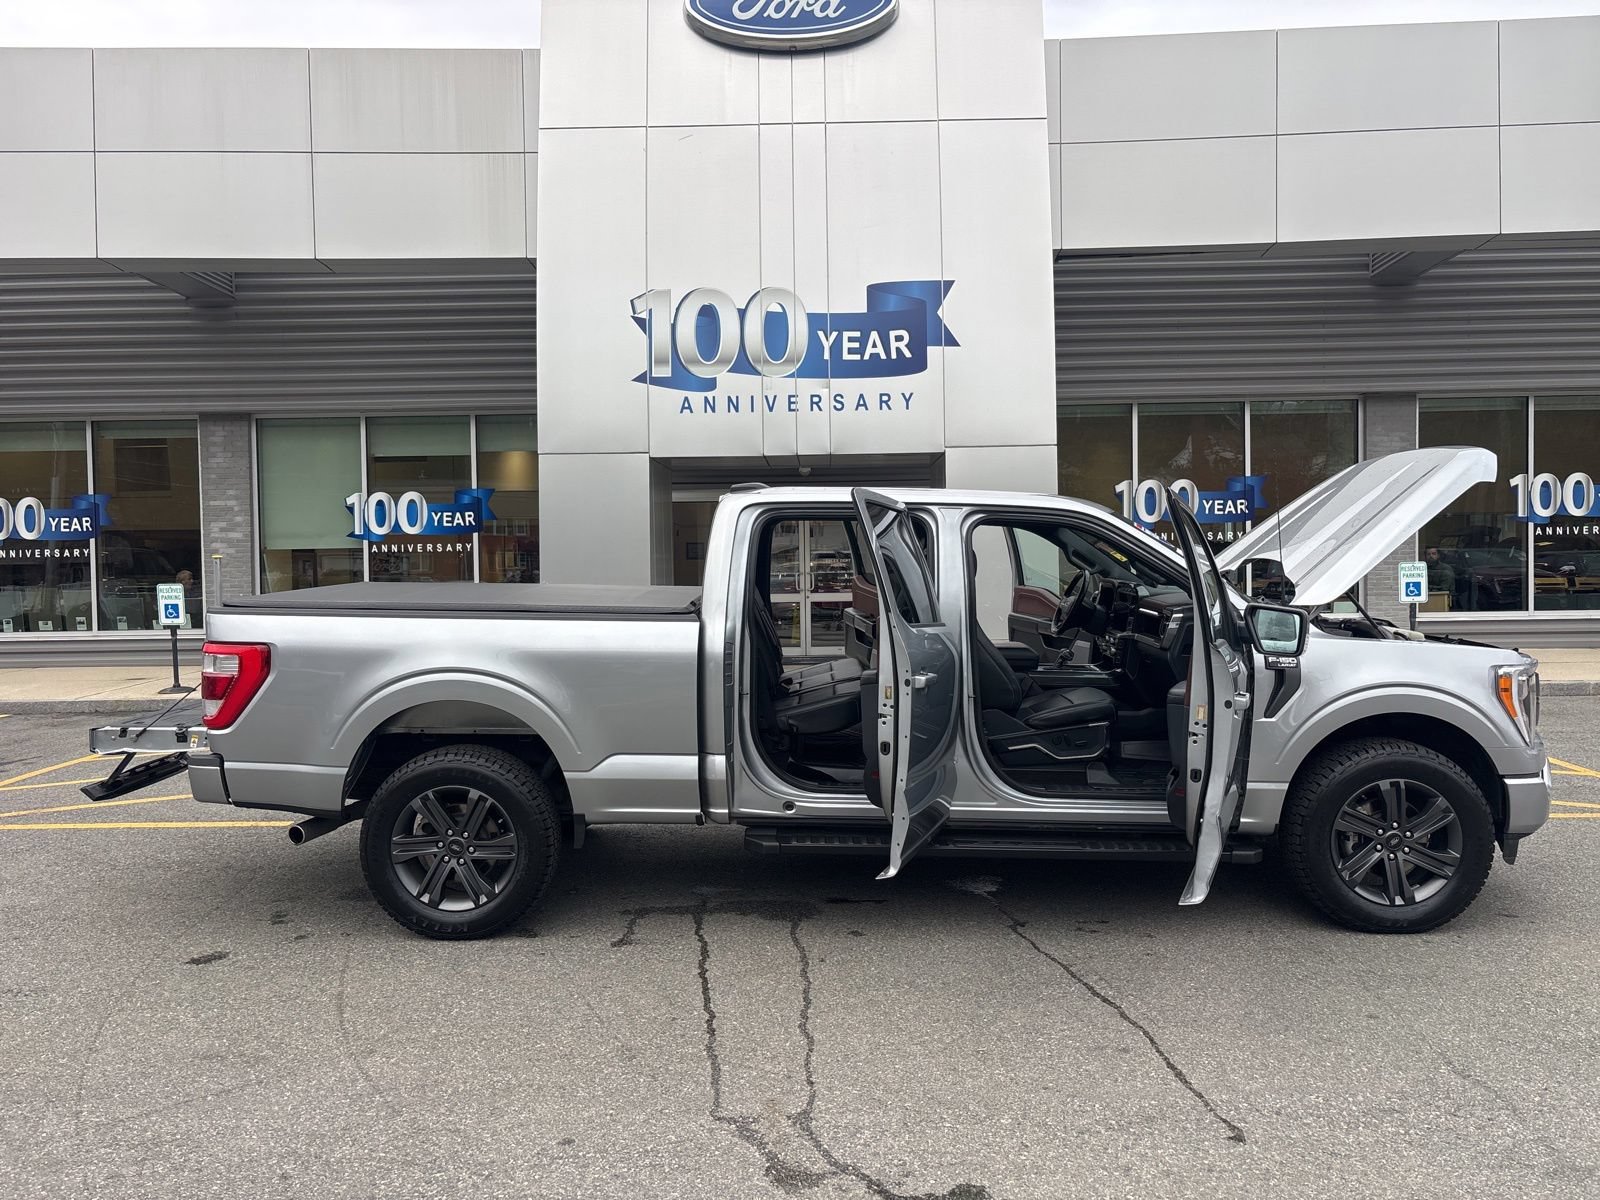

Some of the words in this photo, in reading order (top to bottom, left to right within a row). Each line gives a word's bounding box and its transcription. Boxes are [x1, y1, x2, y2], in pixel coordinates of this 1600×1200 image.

[630, 286, 809, 378] 100
[816, 329, 913, 361] YEAR
[679, 392, 915, 414] ANNIVERSARY
[1509, 472, 1595, 517] 100
[344, 491, 429, 535] 100
[431, 511, 476, 527] YEAR
[1202, 499, 1249, 515] YEAR
[48, 517, 93, 532] YEAR
[371, 543, 473, 553] ANNIVERSARY
